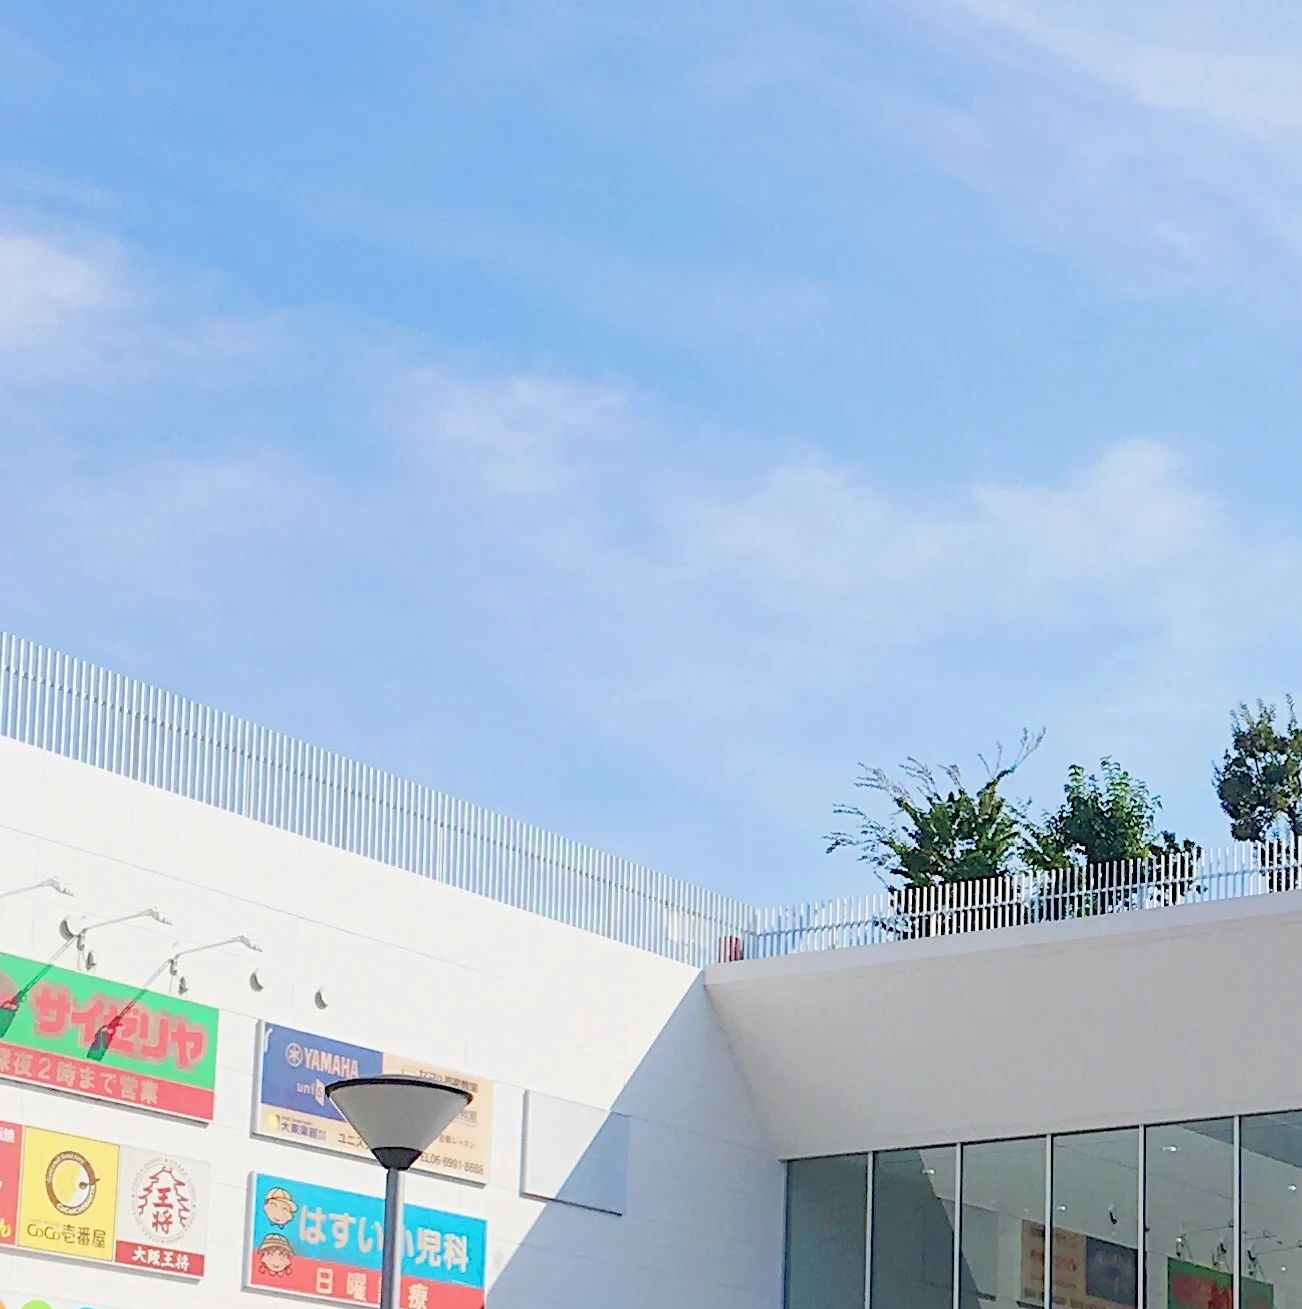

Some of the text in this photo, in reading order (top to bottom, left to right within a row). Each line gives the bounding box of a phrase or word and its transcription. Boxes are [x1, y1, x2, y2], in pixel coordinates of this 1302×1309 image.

[303, 1047, 359, 1078] YAMAHA
[152, 1187, 174, 1235] 王将
[131, 1245, 191, 1273] 大阪王将
